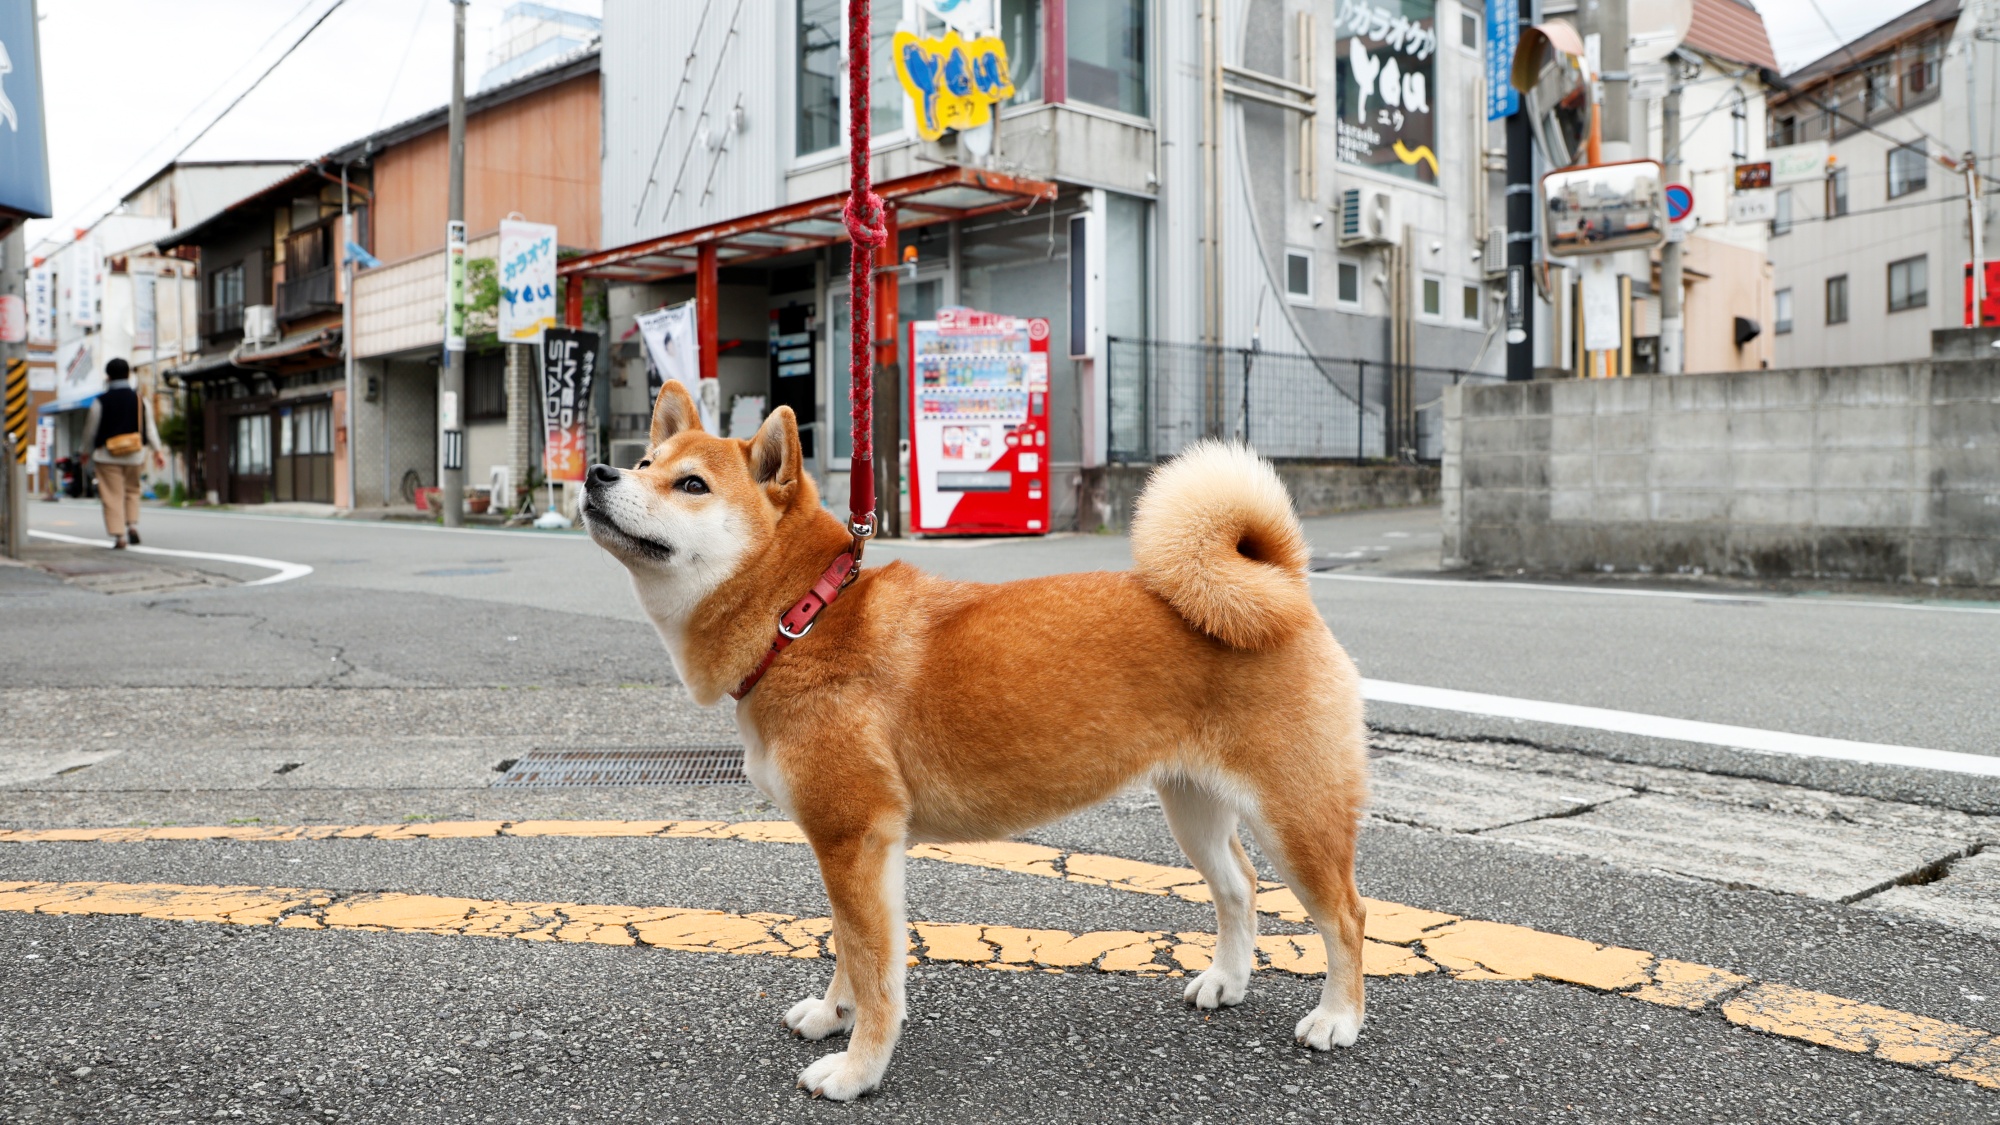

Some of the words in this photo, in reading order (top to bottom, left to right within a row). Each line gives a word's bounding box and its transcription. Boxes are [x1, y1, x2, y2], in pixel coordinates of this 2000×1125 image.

[1348, 3, 1423, 55] カラオケ
[946, 100, 975, 118] ユウ
[1377, 109, 1405, 132] ユウ
[1337, 117, 1381, 145] karaoke
[504, 236, 551, 282] カラオケ
